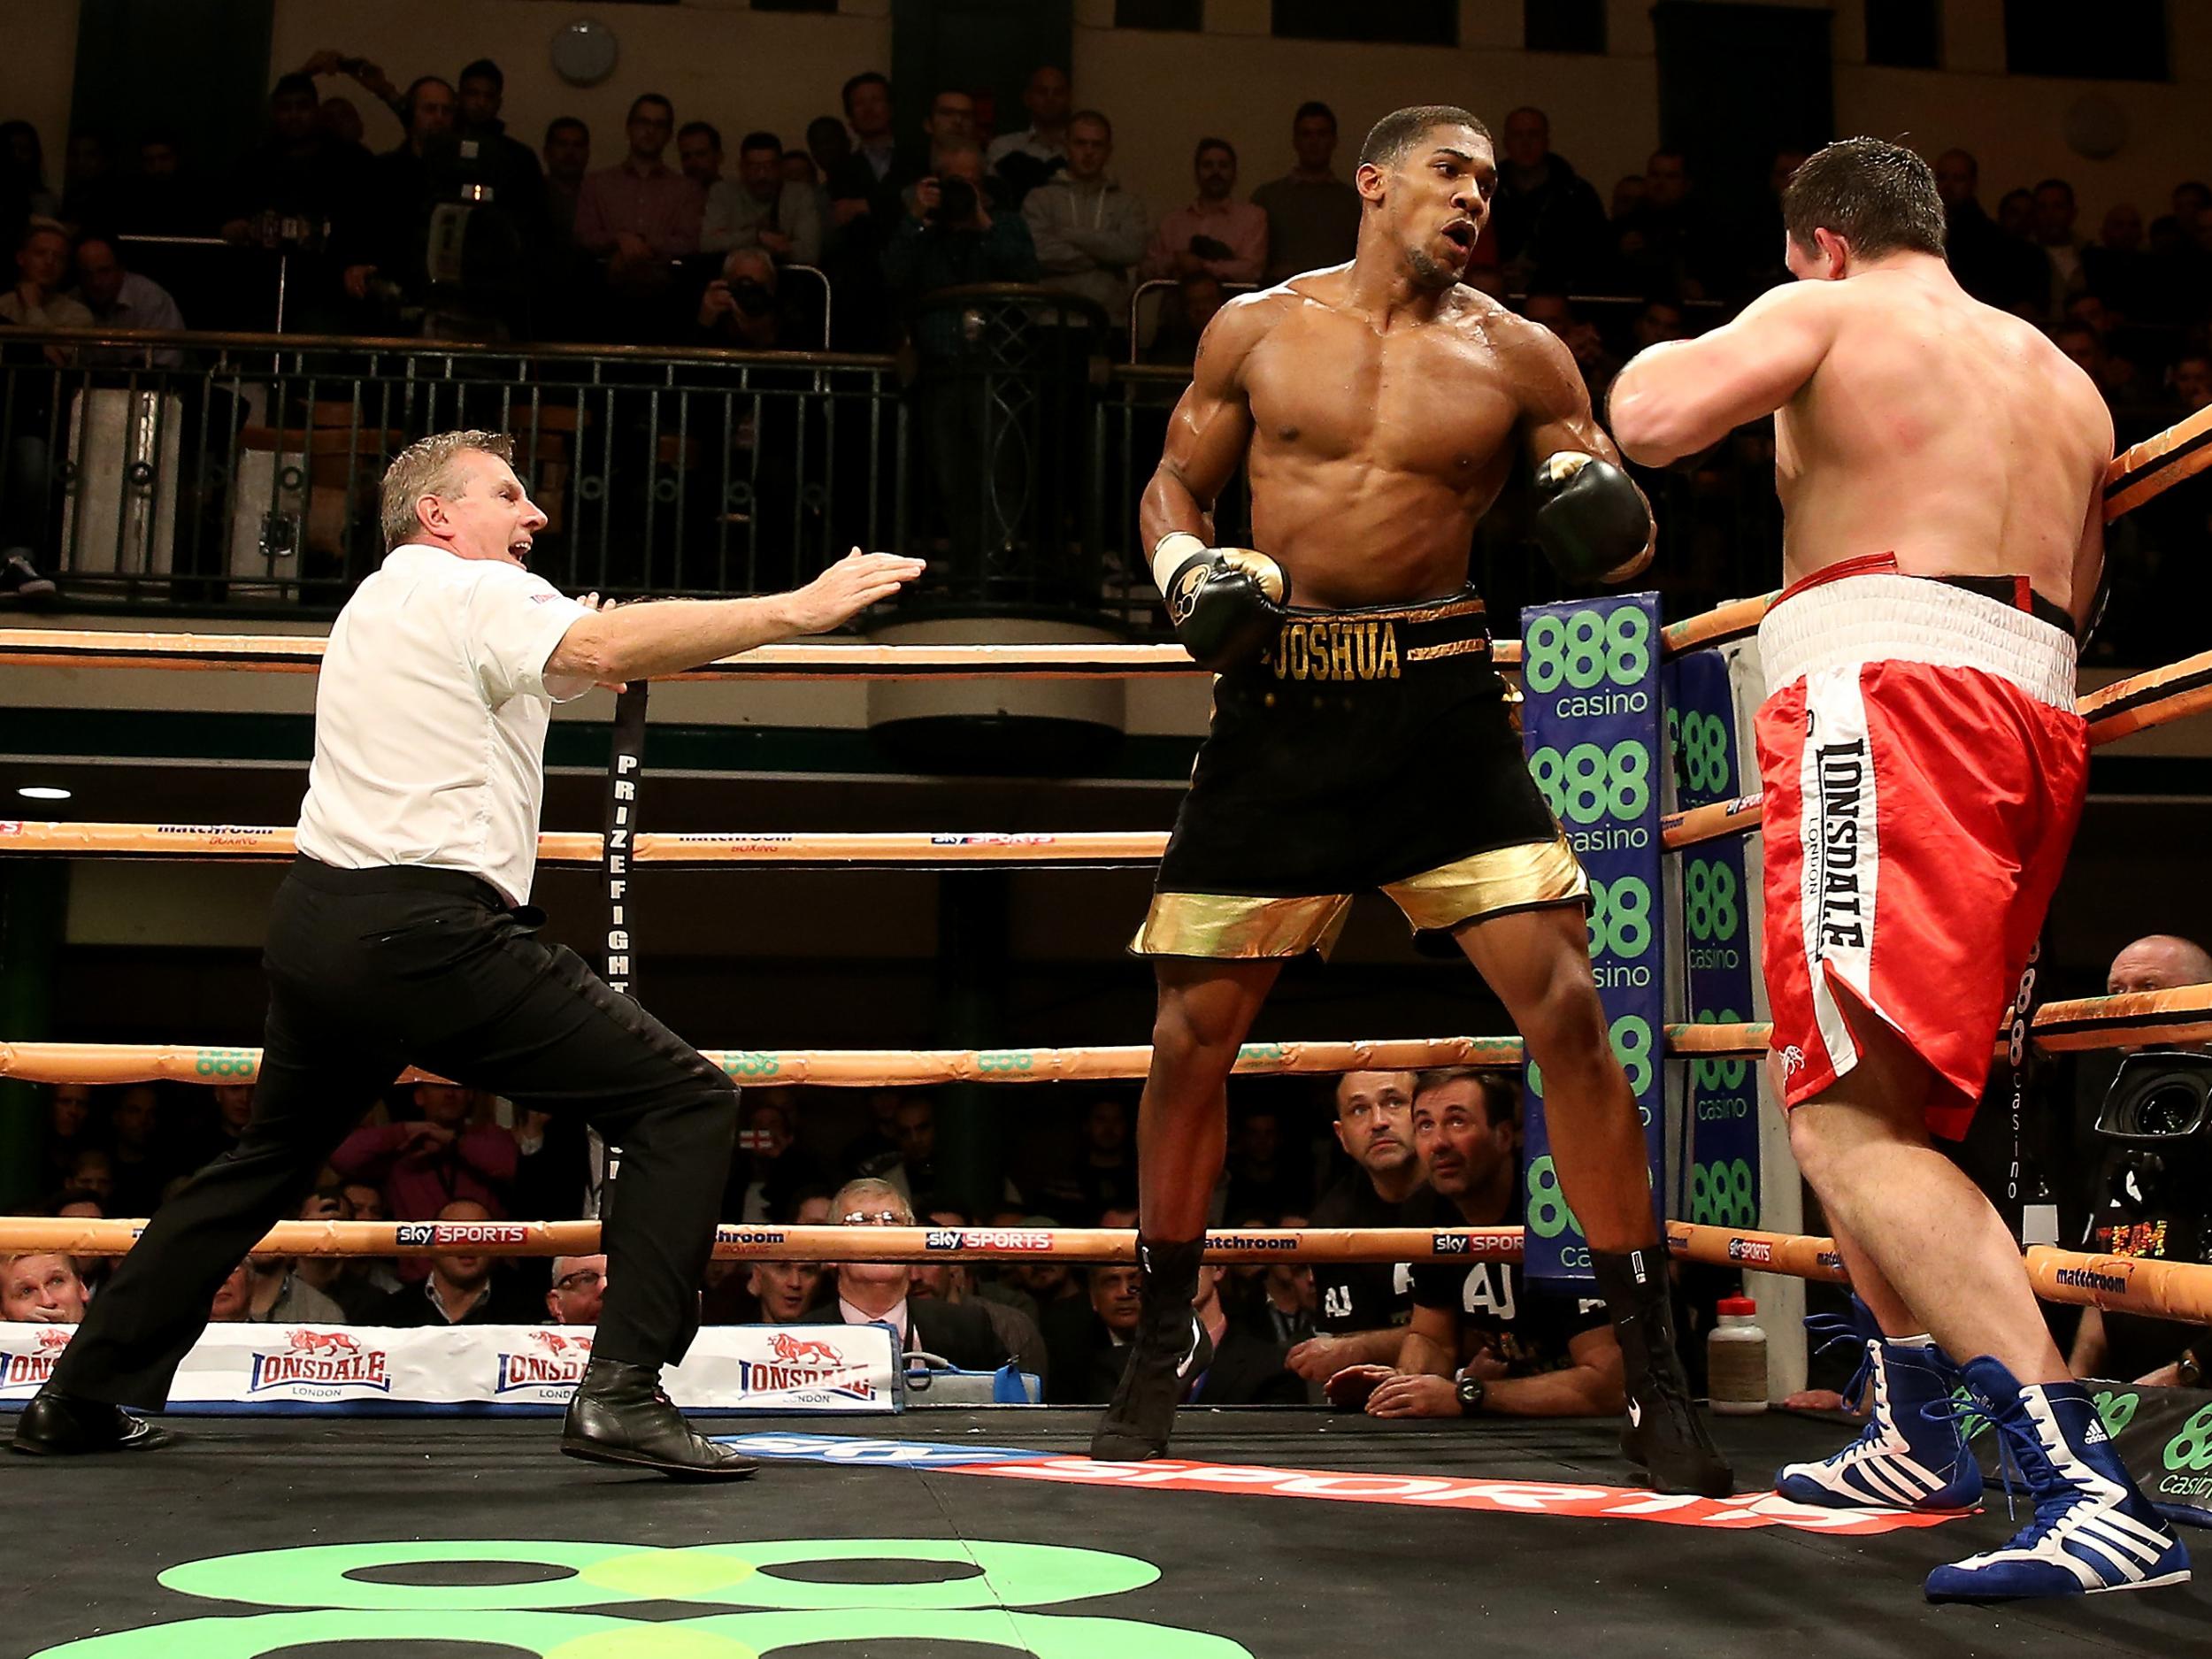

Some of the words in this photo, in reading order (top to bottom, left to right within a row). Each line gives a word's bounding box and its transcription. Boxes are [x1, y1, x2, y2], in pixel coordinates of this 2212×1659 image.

[1274, 621, 1401, 680] JOSHUA
[1526, 605, 1649, 693] 888
[1556, 688, 1647, 719] casino
[1668, 708, 1729, 794] 88
[1528, 740, 1649, 824] 888
[1806, 817, 1819, 895] LONDON
[1814, 738, 1865, 949] LONSDALE
[1687, 858, 1738, 939] 88
[1593, 961, 1650, 987] sino
[1698, 1095, 1747, 1121] casino
[2008, 1071, 2022, 1199] casino
[400, 1225, 432, 1244] sky
[439, 1227, 524, 1242] SPORTS
[718, 1230, 785, 1243] hroom
[929, 1232, 961, 1248] sky
[966, 1233, 1050, 1248] SPORTS
[1204, 1236, 1297, 1249] atchroom
[1436, 1236, 1467, 1253] sky
[1472, 1236, 1524, 1251] SPOR
[2057, 1268, 2126, 1294] matchroom
[248, 1351, 390, 1393] LONSDALE
[495, 1353, 588, 1394] LONSD
[293, 1387, 342, 1397] LONDON
[540, 1389, 571, 1398] LOND
